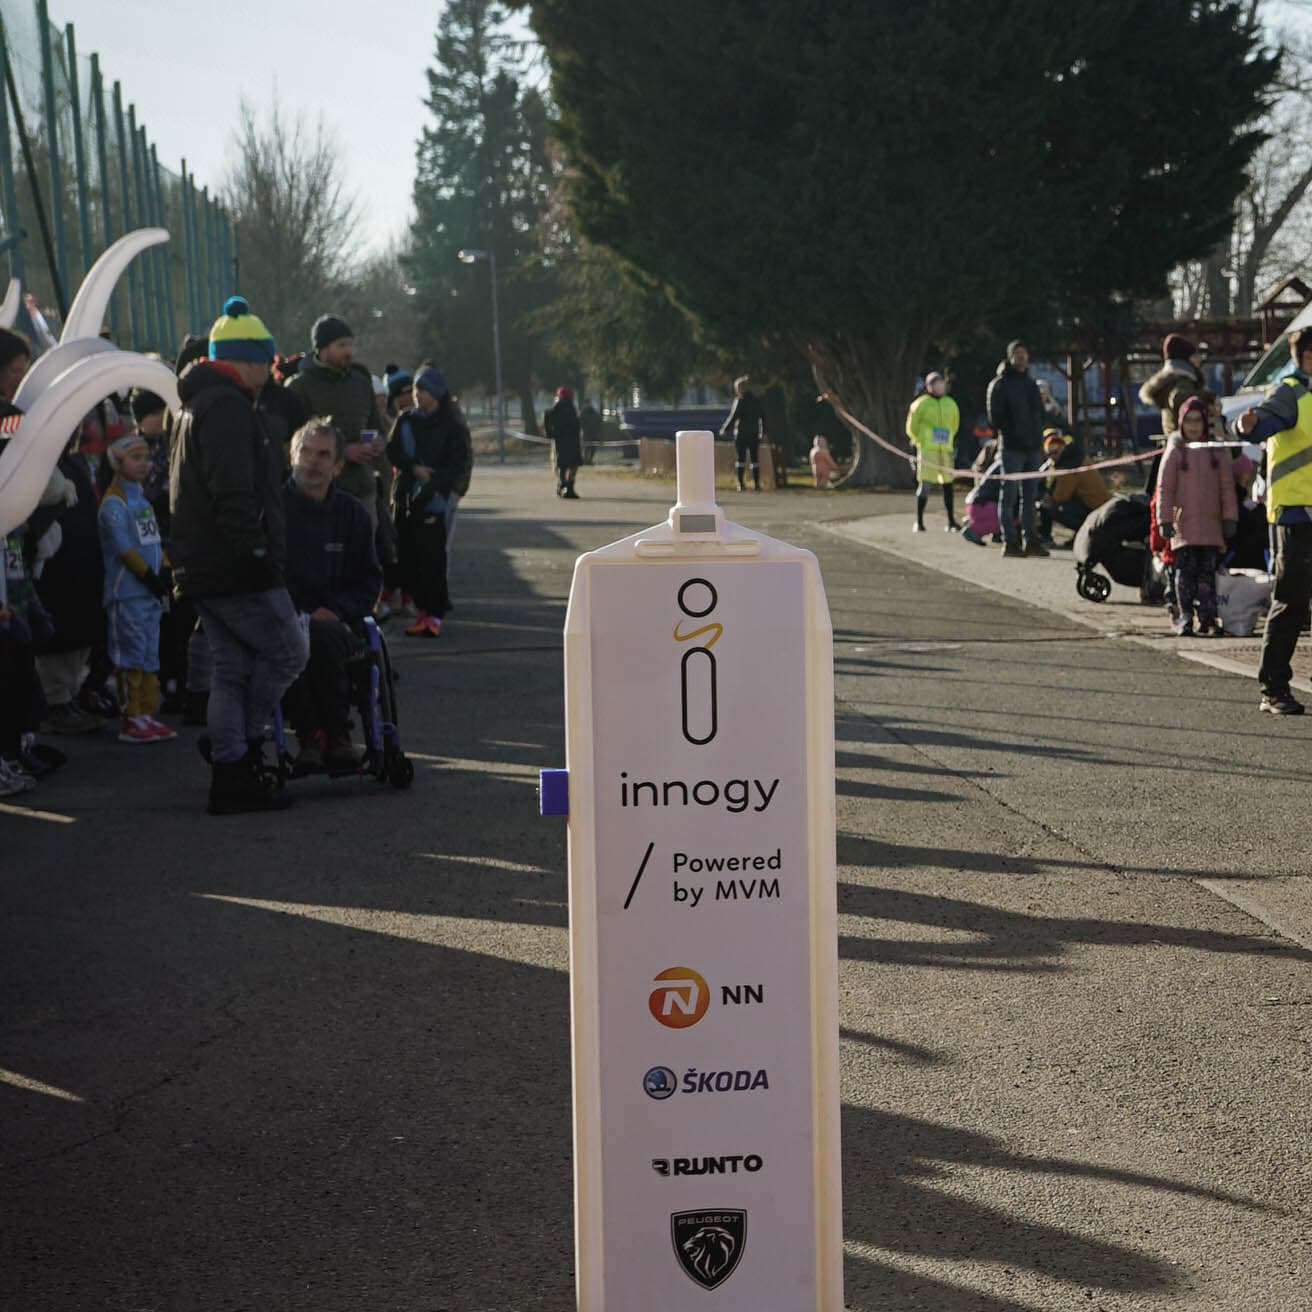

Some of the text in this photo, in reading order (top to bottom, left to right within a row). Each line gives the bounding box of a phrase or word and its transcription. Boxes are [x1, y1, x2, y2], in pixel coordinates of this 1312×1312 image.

[620, 771, 780, 814] innogy
[673, 848, 782, 873] Powered
[673, 878, 781, 908] by MVM
[720, 984, 764, 1006] NN
[681, 1068, 769, 1094] ŠKODA
[673, 1154, 763, 1177] RUNTO
[678, 1215, 740, 1226] PEUGEOT
